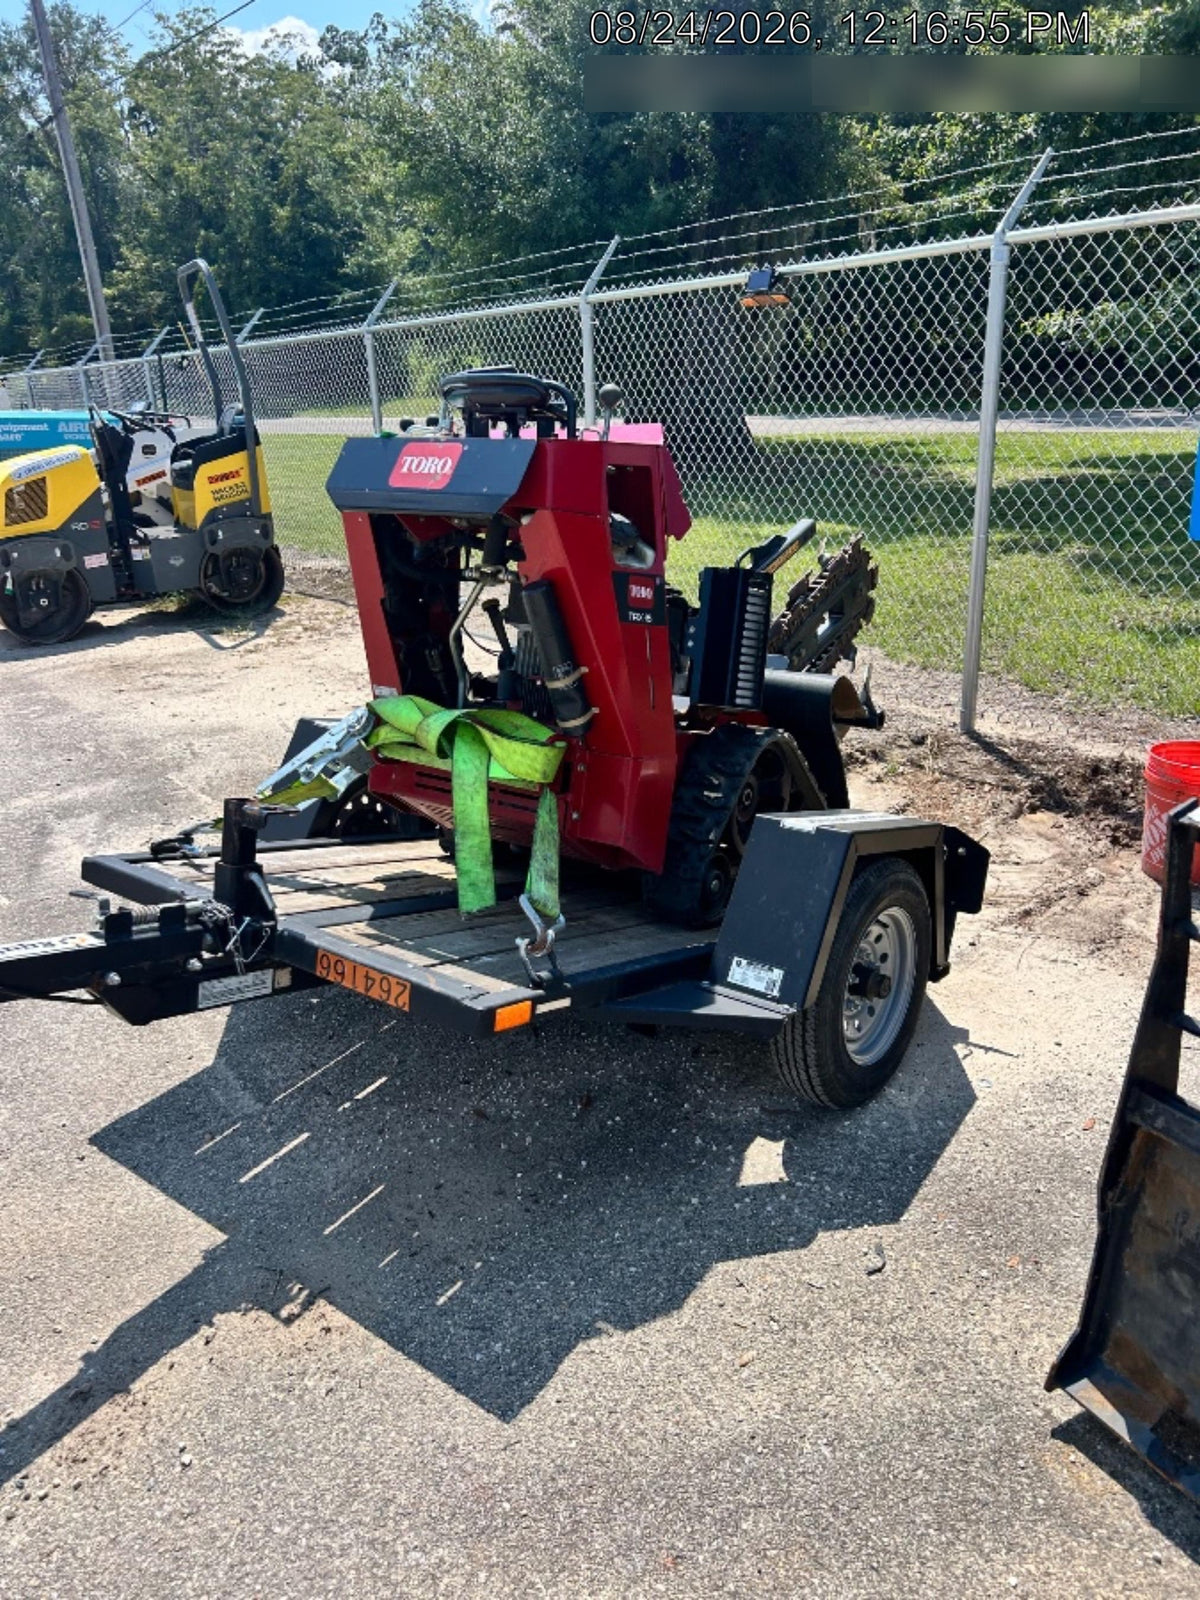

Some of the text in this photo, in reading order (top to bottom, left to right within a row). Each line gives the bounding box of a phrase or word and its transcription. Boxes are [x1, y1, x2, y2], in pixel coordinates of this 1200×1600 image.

[400, 456, 453, 474] TORO
[629, 584, 654, 600] TORO
[319, 953, 408, 1009] 264166
